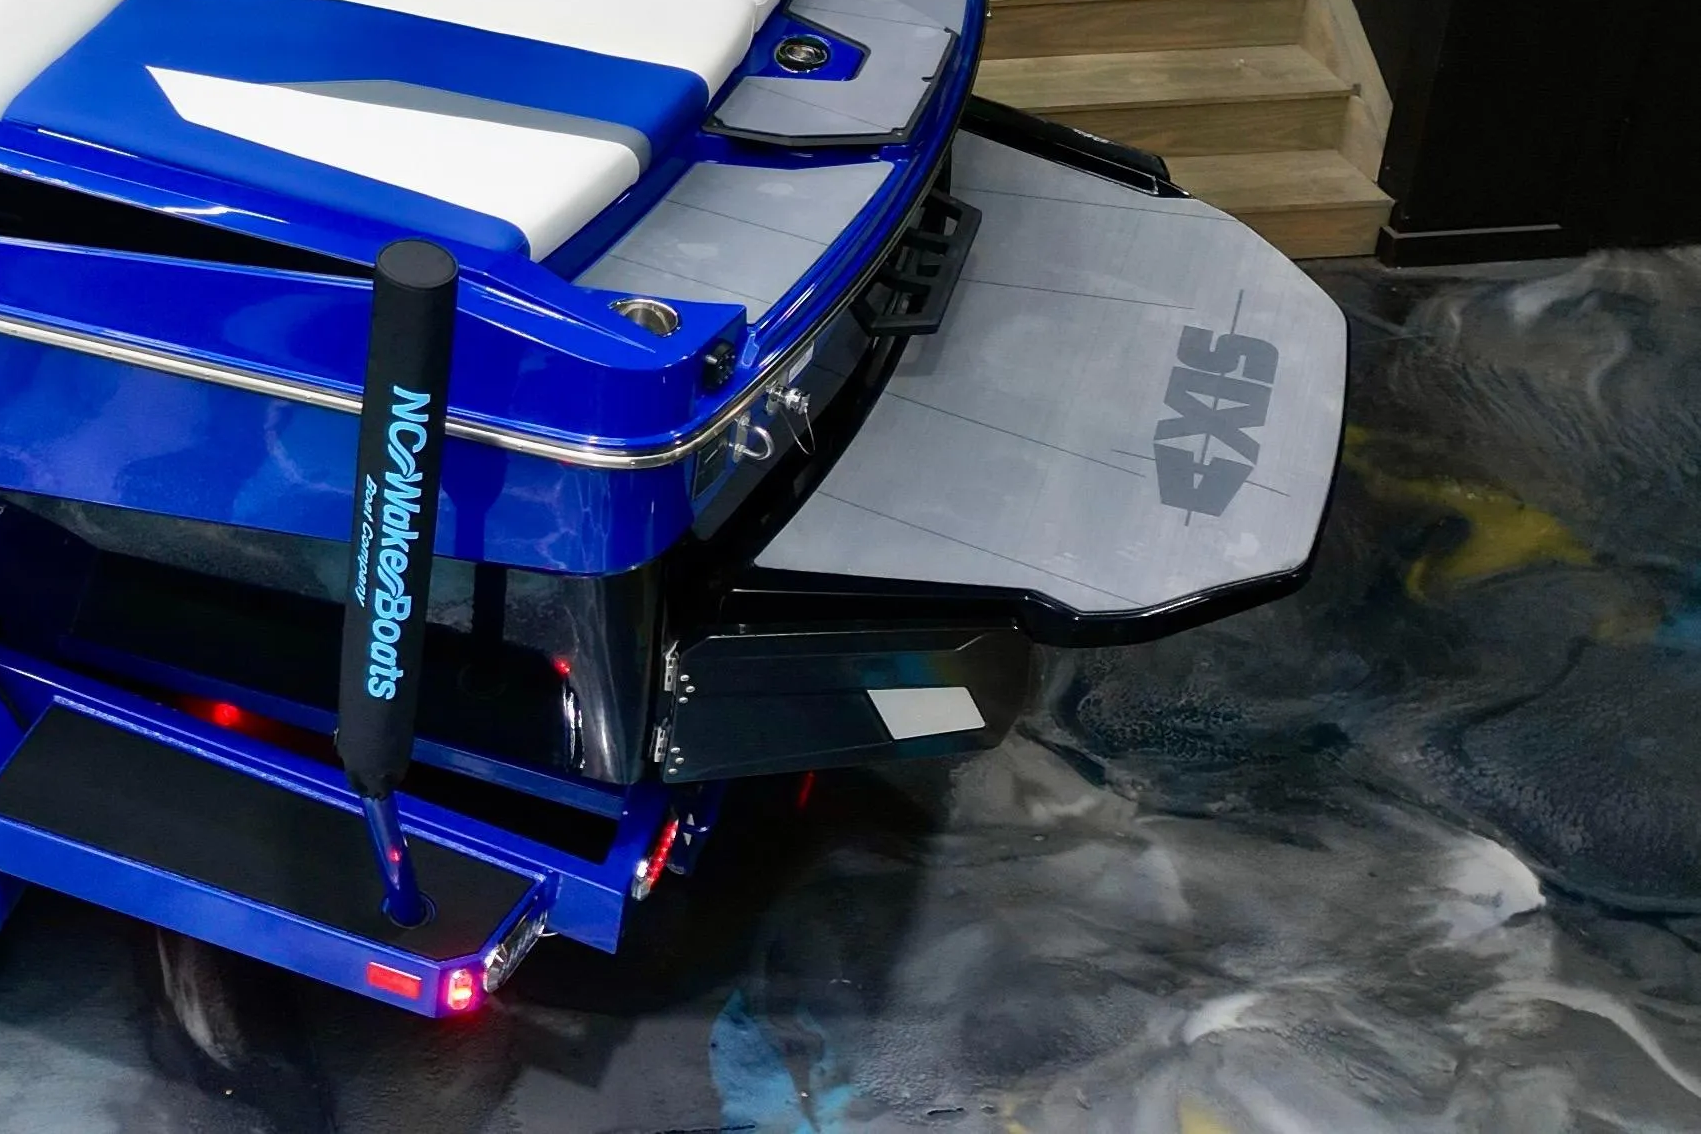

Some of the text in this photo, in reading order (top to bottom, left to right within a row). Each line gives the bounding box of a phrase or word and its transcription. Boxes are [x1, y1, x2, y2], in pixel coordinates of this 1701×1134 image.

[1153, 325, 1279, 517] AXIS
[355, 474, 378, 608] Boat Company
